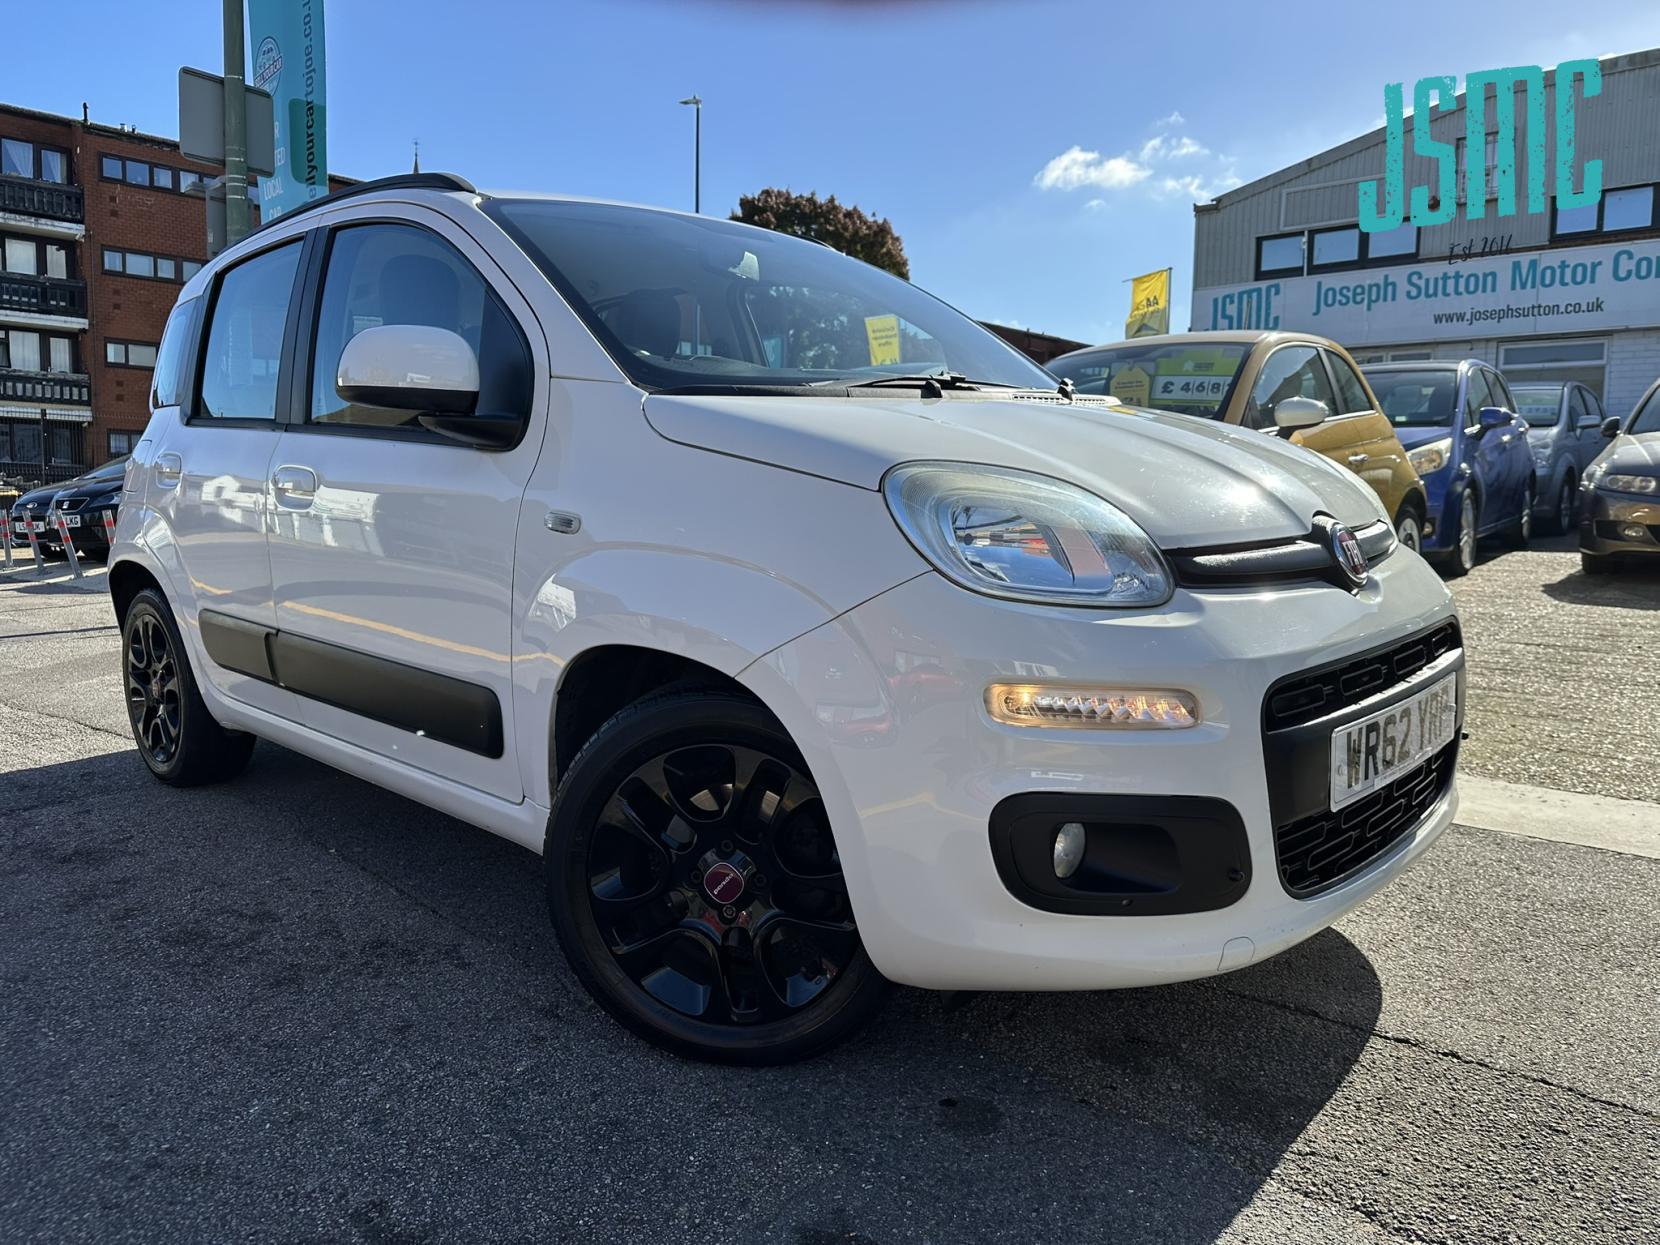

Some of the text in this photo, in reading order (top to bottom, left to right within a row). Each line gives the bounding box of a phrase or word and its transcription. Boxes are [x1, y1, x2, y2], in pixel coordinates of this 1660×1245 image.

[264, 177, 284, 200] LOCAL
[1204, 283, 1280, 330] JSMC
[1312, 274, 1397, 316] Joseph
[1406, 270, 1498, 300] Sutton
[1510, 258, 1602, 291] Motor
[1433, 297, 1605, 326] www.josephsutton.co.uk
[1347, 707, 1411, 789] WR62
